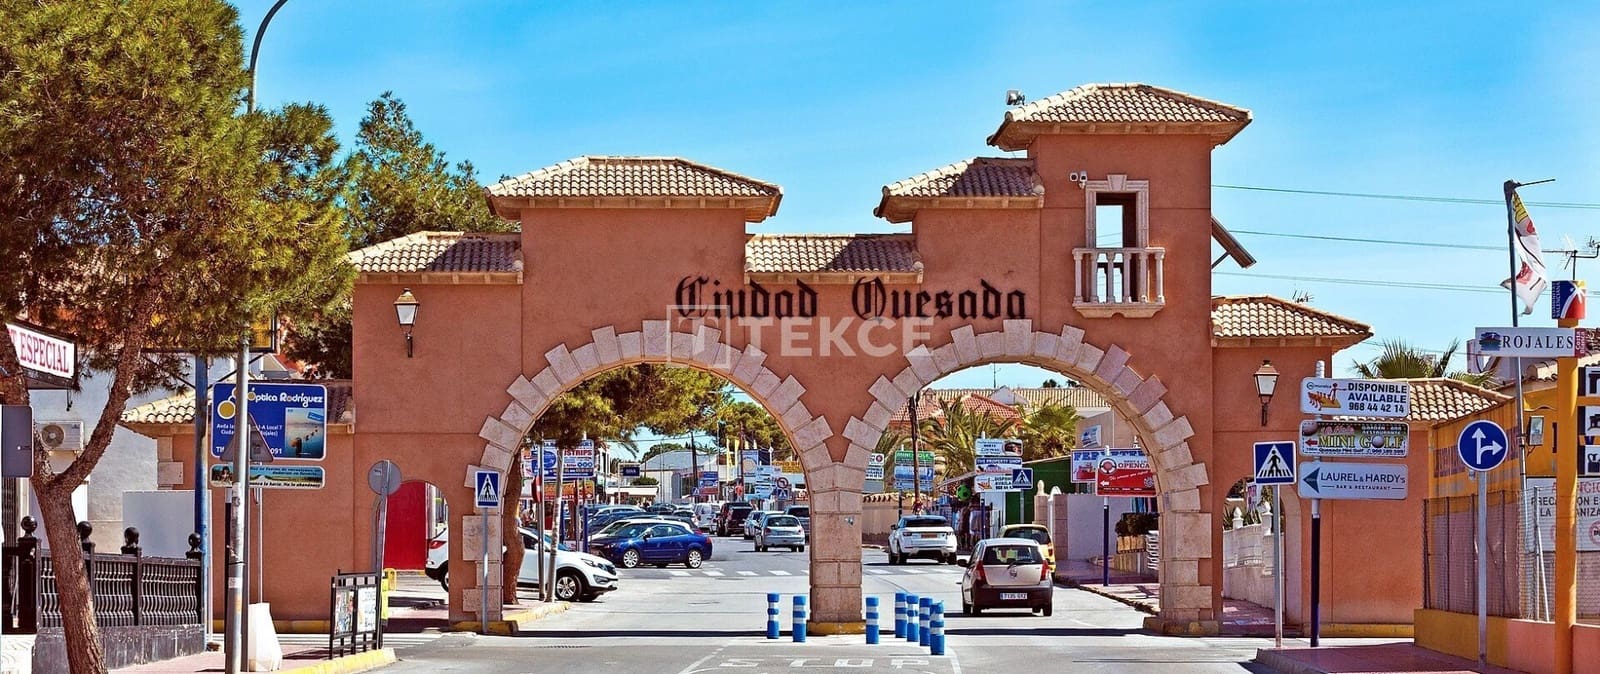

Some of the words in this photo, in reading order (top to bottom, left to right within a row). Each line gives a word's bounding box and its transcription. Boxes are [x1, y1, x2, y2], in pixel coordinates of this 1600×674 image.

[675, 276, 819, 320] Ciudad
[851, 276, 1026, 324] Quesada
[1503, 335, 1573, 349] ROJALES
[20, 331, 69, 373] ESPECIAL
[1348, 383, 1407, 394] DISPONIBLE
[280, 392, 323, 407] Rodríguez
[1348, 393, 1407, 404] AVAILABLE
[1348, 402, 1365, 411] 968
[1367, 403, 1378, 412] 44
[1380, 404, 1392, 413] 42
[1394, 404, 1405, 413] 14
[1318, 435, 1355, 449] MINI
[1359, 435, 1404, 449] GOLF
[1540, 508, 1552, 517] LA
